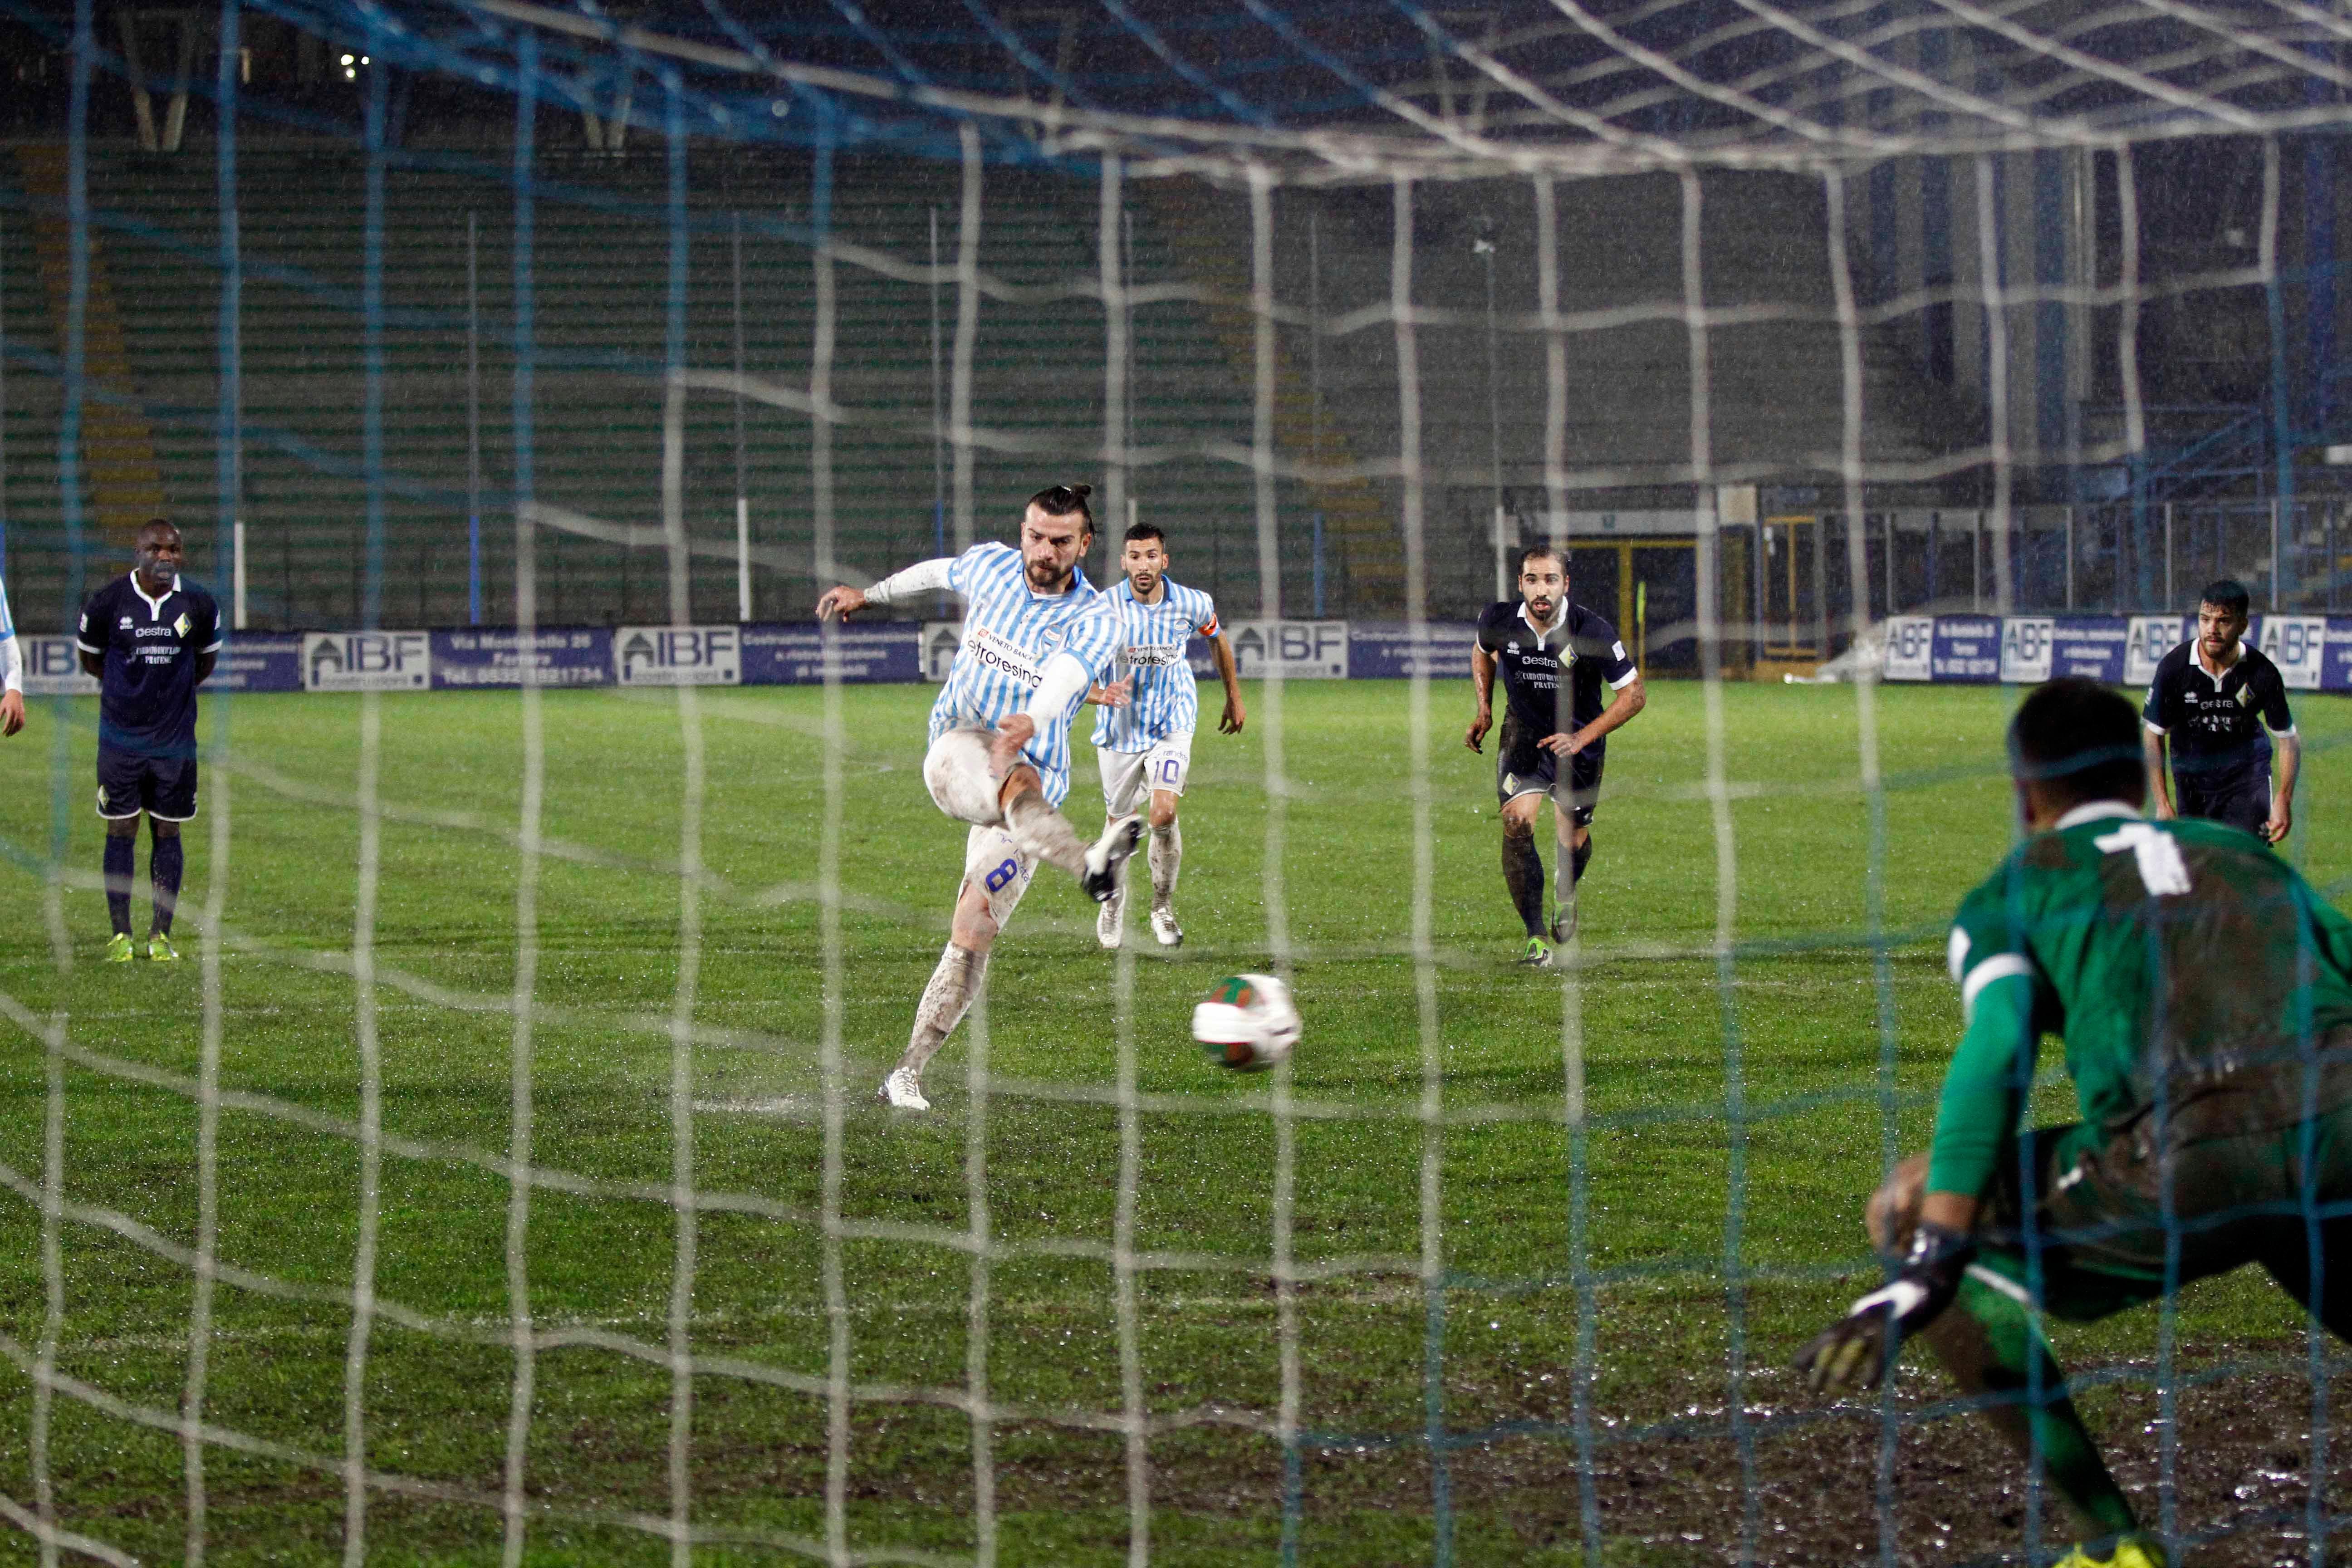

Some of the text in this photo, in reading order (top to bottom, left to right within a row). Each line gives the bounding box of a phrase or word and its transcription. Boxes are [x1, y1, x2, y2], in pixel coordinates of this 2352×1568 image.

[989, 634, 1012, 651] VENETO
[1531, 657, 1558, 668] estra
[1153, 760, 1180, 784] 10
[2093, 823, 2192, 897] 1
[985, 858, 1018, 893] 8
